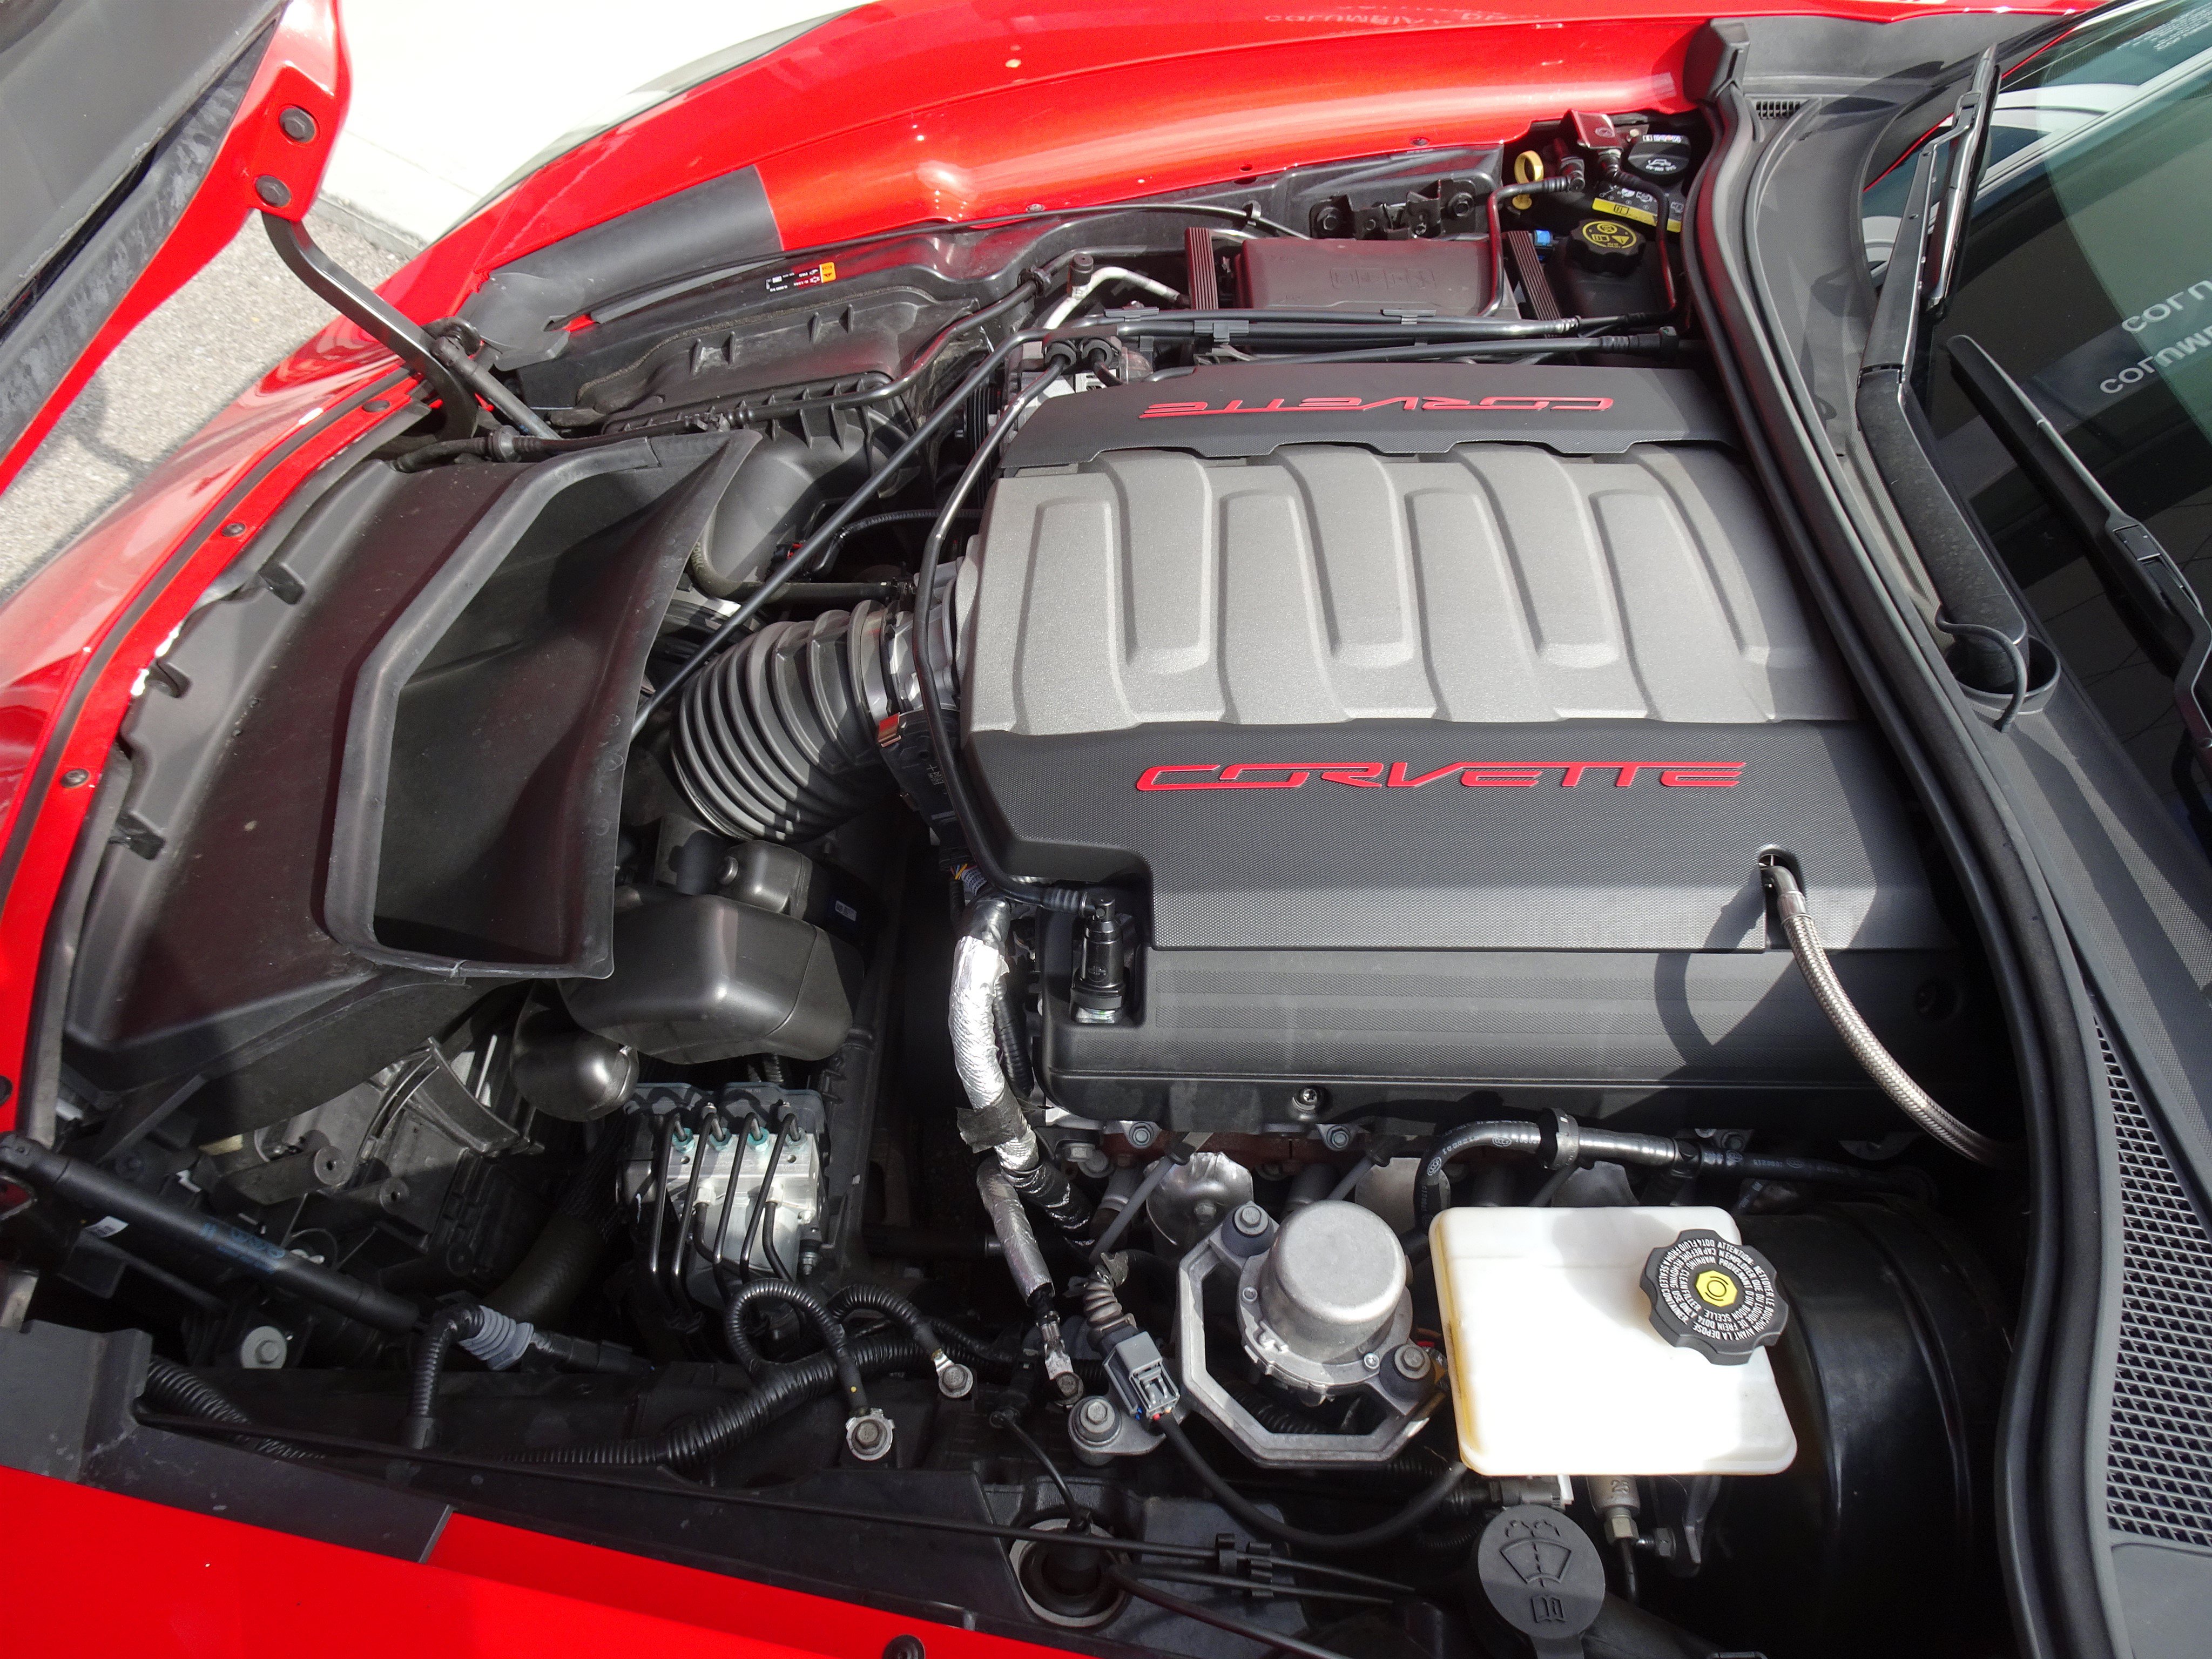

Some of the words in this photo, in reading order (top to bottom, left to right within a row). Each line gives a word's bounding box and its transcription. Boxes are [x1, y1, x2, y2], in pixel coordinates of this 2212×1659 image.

[1139, 397, 1613, 418] CORVETTE
[1136, 761, 1745, 791] CORVETTE
[1678, 1239, 1698, 1252] FLUID
[1703, 1247, 1716, 1256] CAP
[1664, 1246, 1682, 1263] FROM
[1679, 1247, 1703, 1263] BEFORE
[1659, 1264, 1669, 1288] SEALED
[1679, 1269, 1690, 1290] CLEAN
[1718, 1258, 1754, 1289] PROVENANT
[1753, 1265, 1775, 1297] NETTOYER
[1751, 1279, 1764, 1292] QUE
[1671, 1290, 1684, 1304] USE
[1681, 1290, 1702, 1312] FILLER
[1755, 1293, 1765, 1303] DU
[1765, 1297, 1775, 1307] LE
[1680, 1302, 1698, 1318] ONLY
[1731, 1304, 1751, 1320] BIDON
[1745, 1303, 1764, 1325] LIQUIDE
[1697, 1315, 1716, 1329] DOT4
[1717, 1322, 1739, 1331] FREIN
[1737, 1319, 1749, 1329] DE
[1752, 1306, 1775, 1333] BOUCHON
[1721, 1332, 1733, 1340] LA
[1734, 1327, 1755, 1340] AVANT
